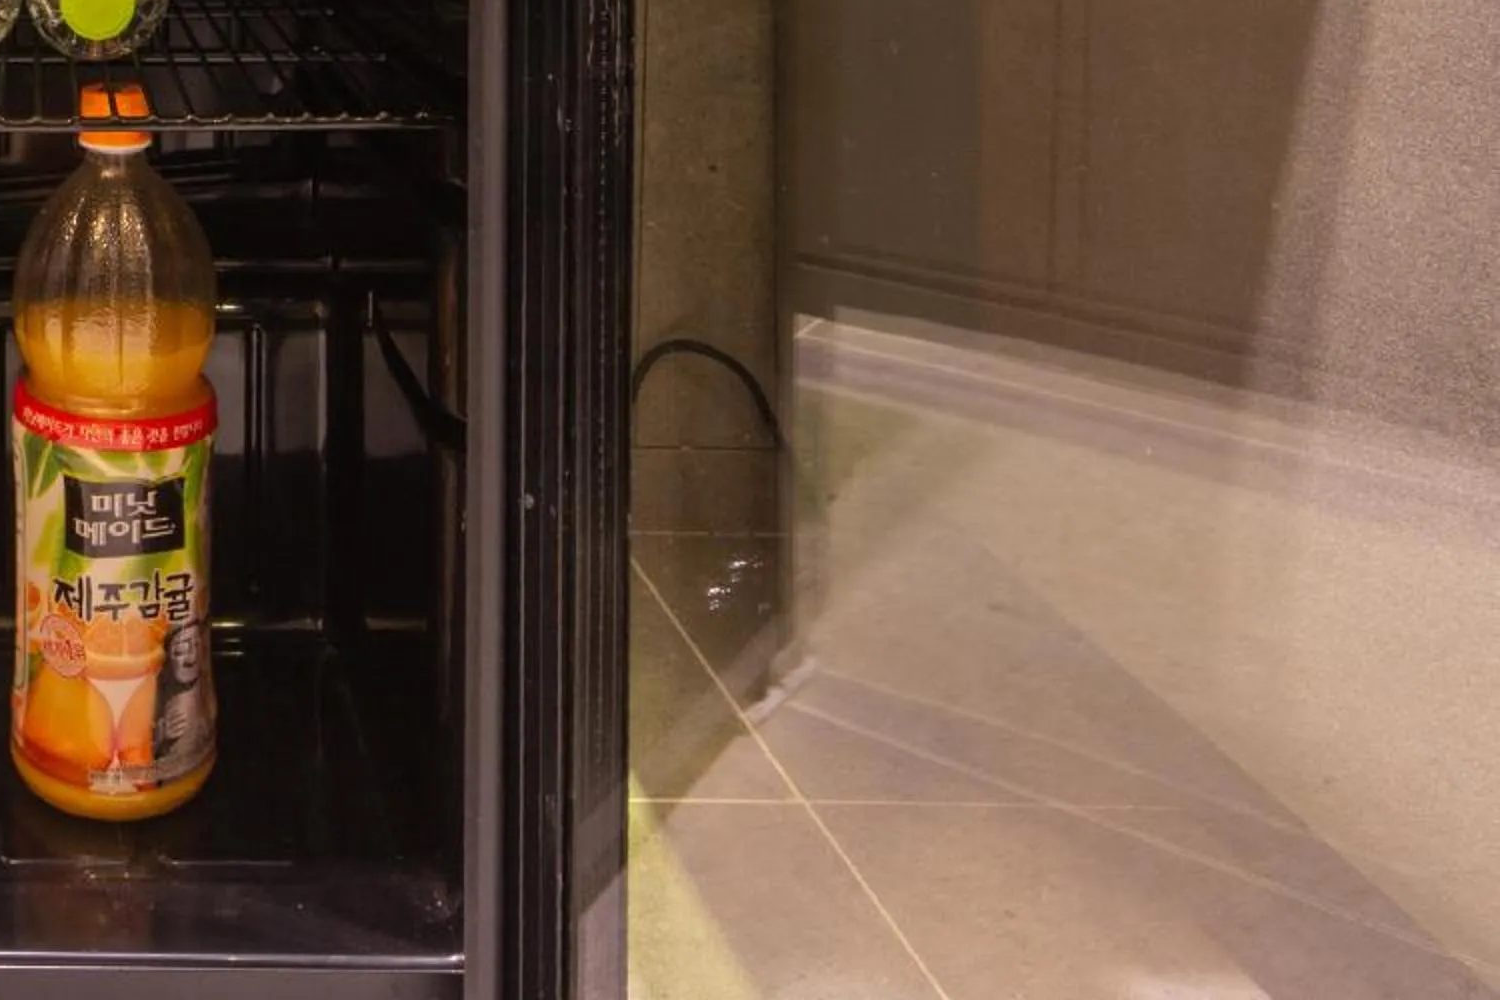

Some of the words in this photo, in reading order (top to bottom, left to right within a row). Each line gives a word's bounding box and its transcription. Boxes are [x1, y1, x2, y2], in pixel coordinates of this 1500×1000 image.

[91, 491, 156, 518] 미닛
[75, 518, 175, 545] 메이드
[54, 569, 195, 622] 제주감귤
